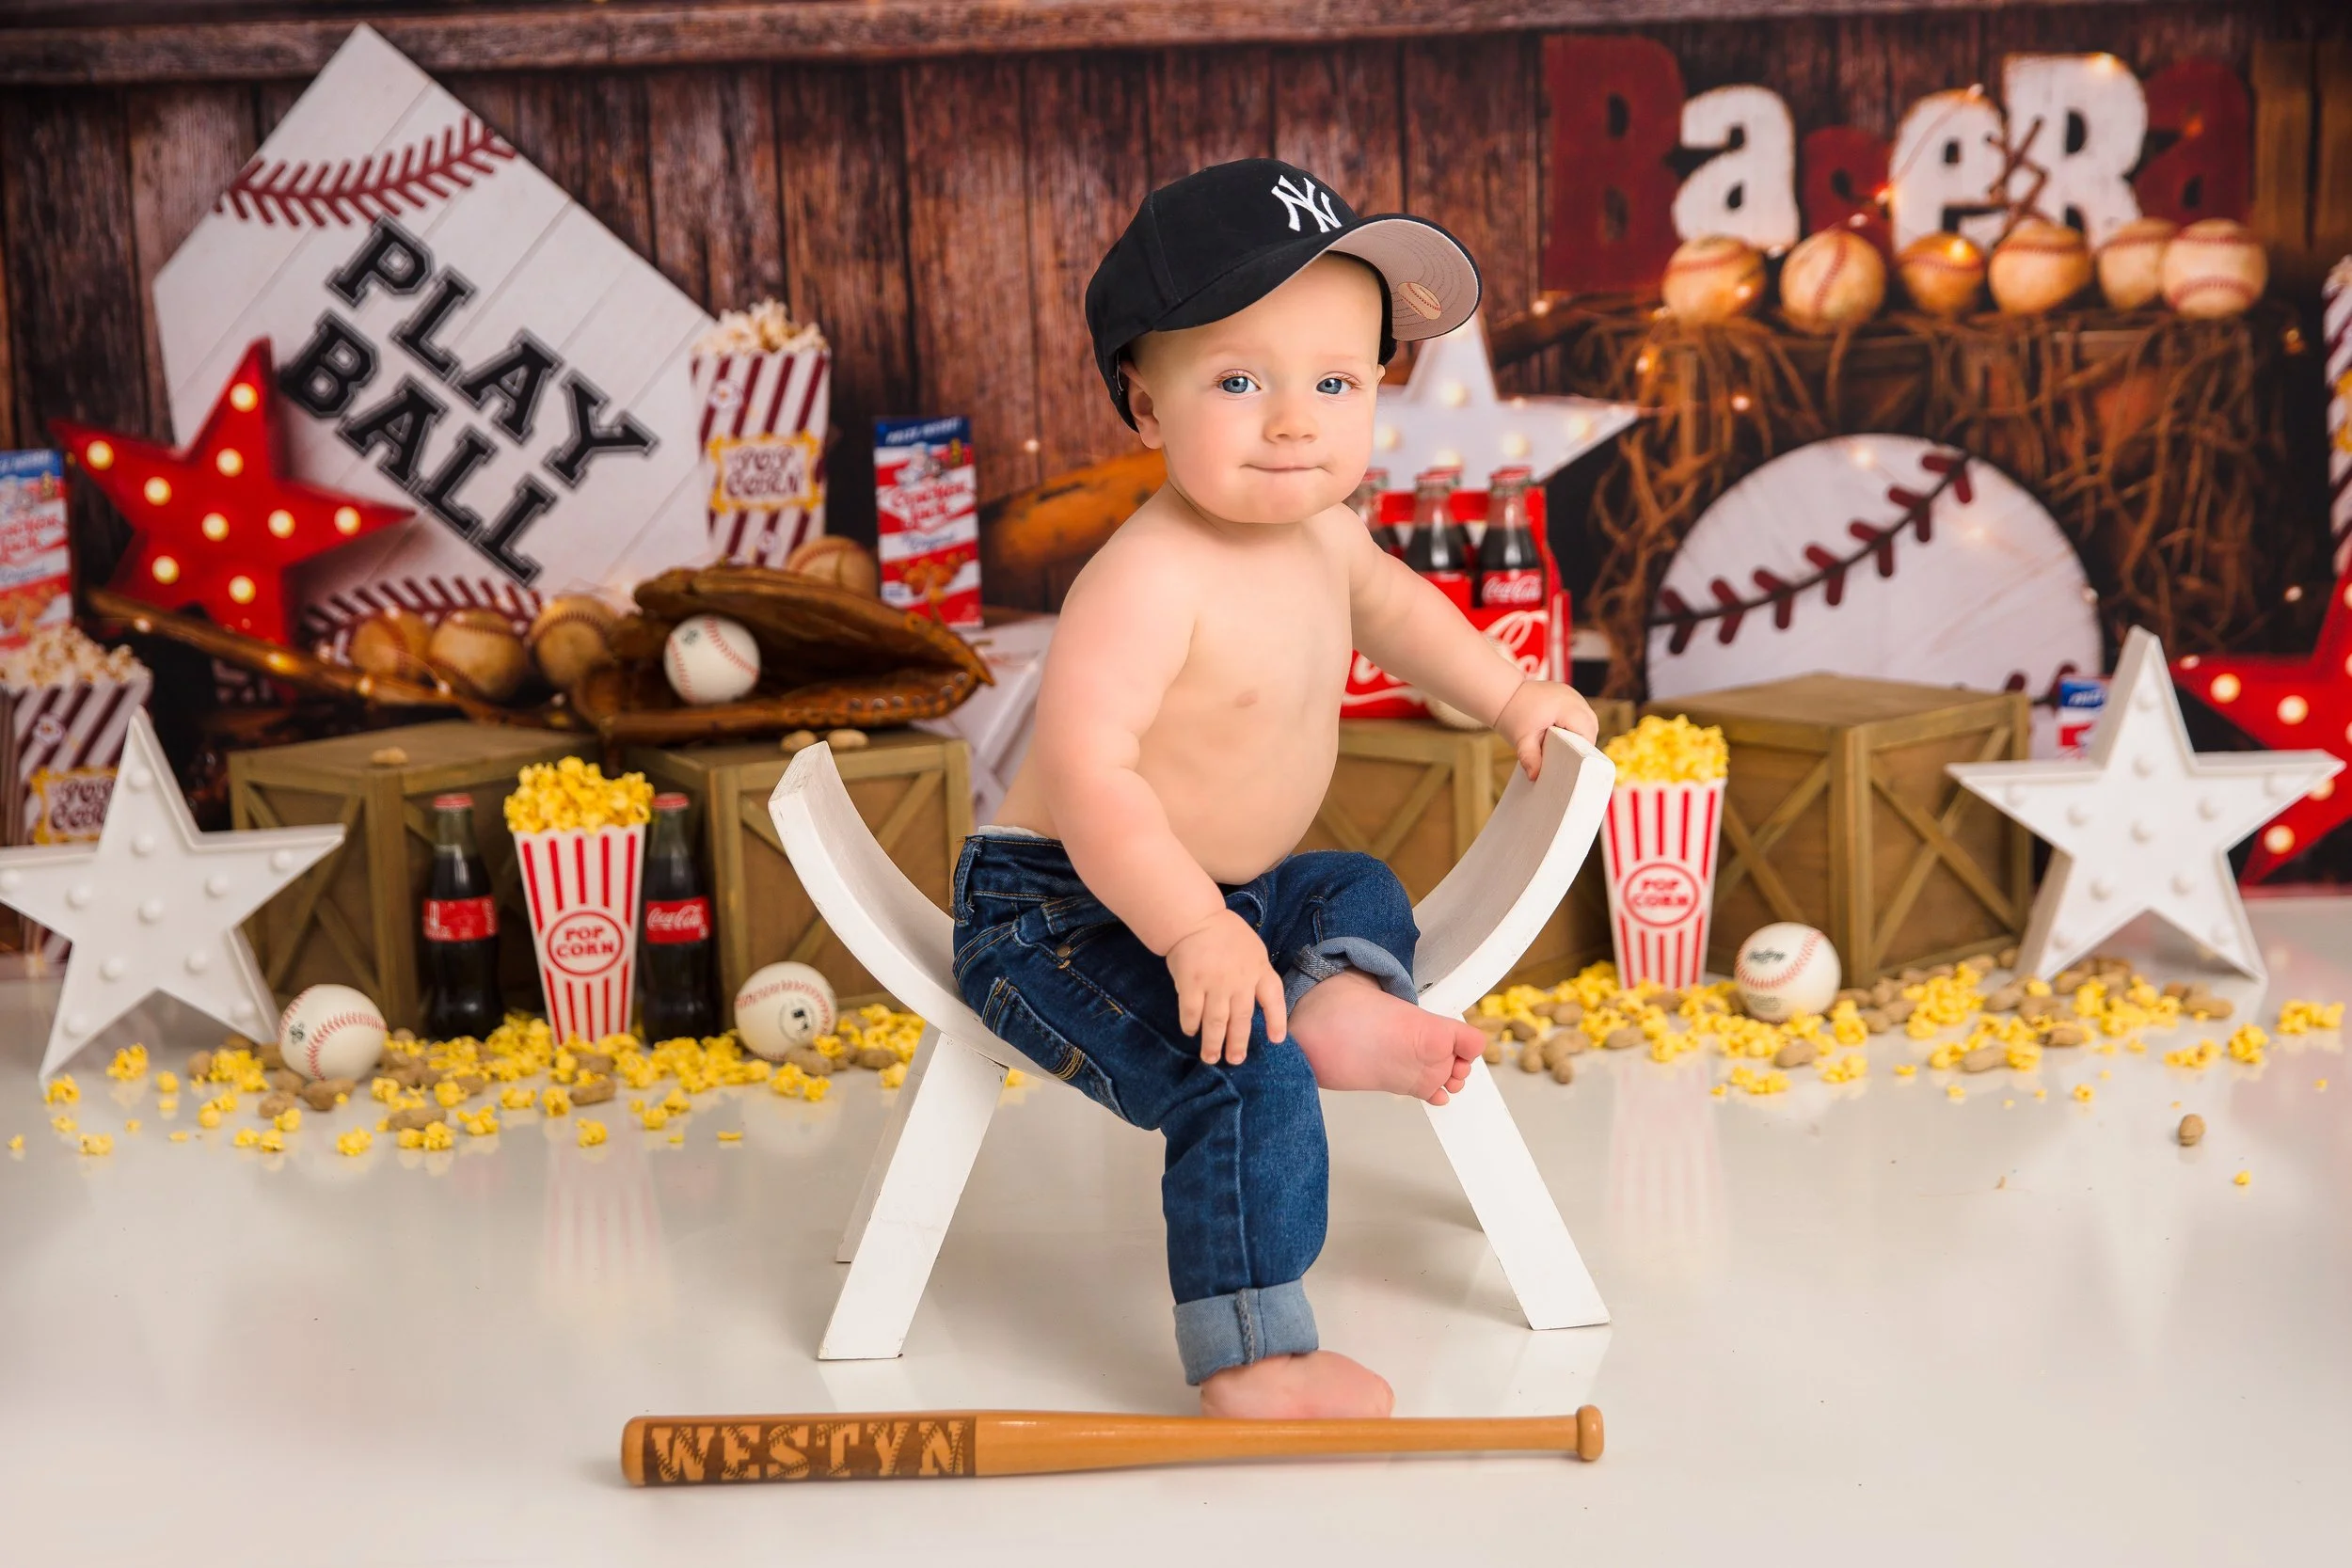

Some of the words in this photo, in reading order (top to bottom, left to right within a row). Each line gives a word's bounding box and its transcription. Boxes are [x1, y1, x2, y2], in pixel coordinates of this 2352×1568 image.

[1270, 174, 1343, 233] NY
[325, 214, 660, 489] PLAY
[280, 309, 559, 587] BALL
[735, 446, 796, 470] POP
[726, 470, 799, 498] CORN
[1642, 878, 1680, 892] POP
[1633, 893, 1690, 909] CORN
[564, 926, 604, 942] POP
[556, 942, 612, 958] CORN
[650, 1419, 965, 1483] WESTYN
